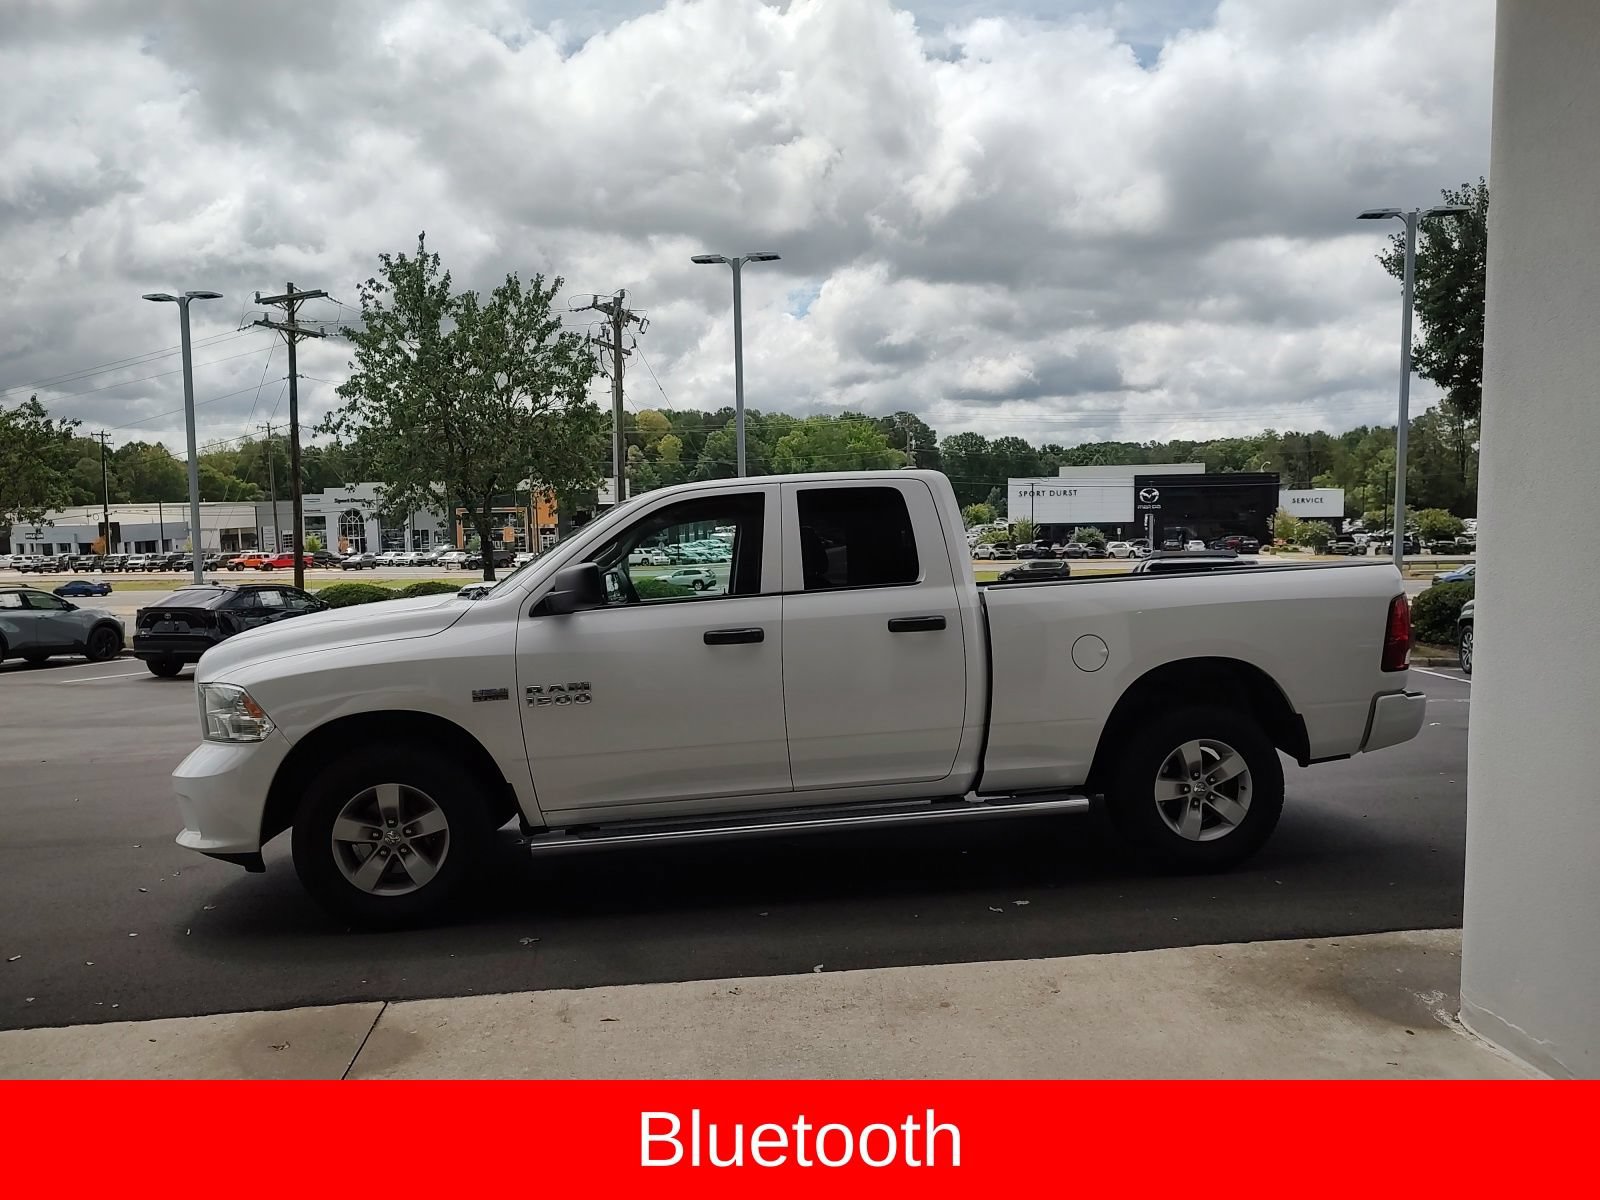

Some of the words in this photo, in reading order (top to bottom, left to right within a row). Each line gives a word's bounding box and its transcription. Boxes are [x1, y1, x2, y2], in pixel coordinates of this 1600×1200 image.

[1050, 489, 1078, 497] DURST
[526, 682, 591, 694] RAM
[526, 693, 592, 707] 1500
